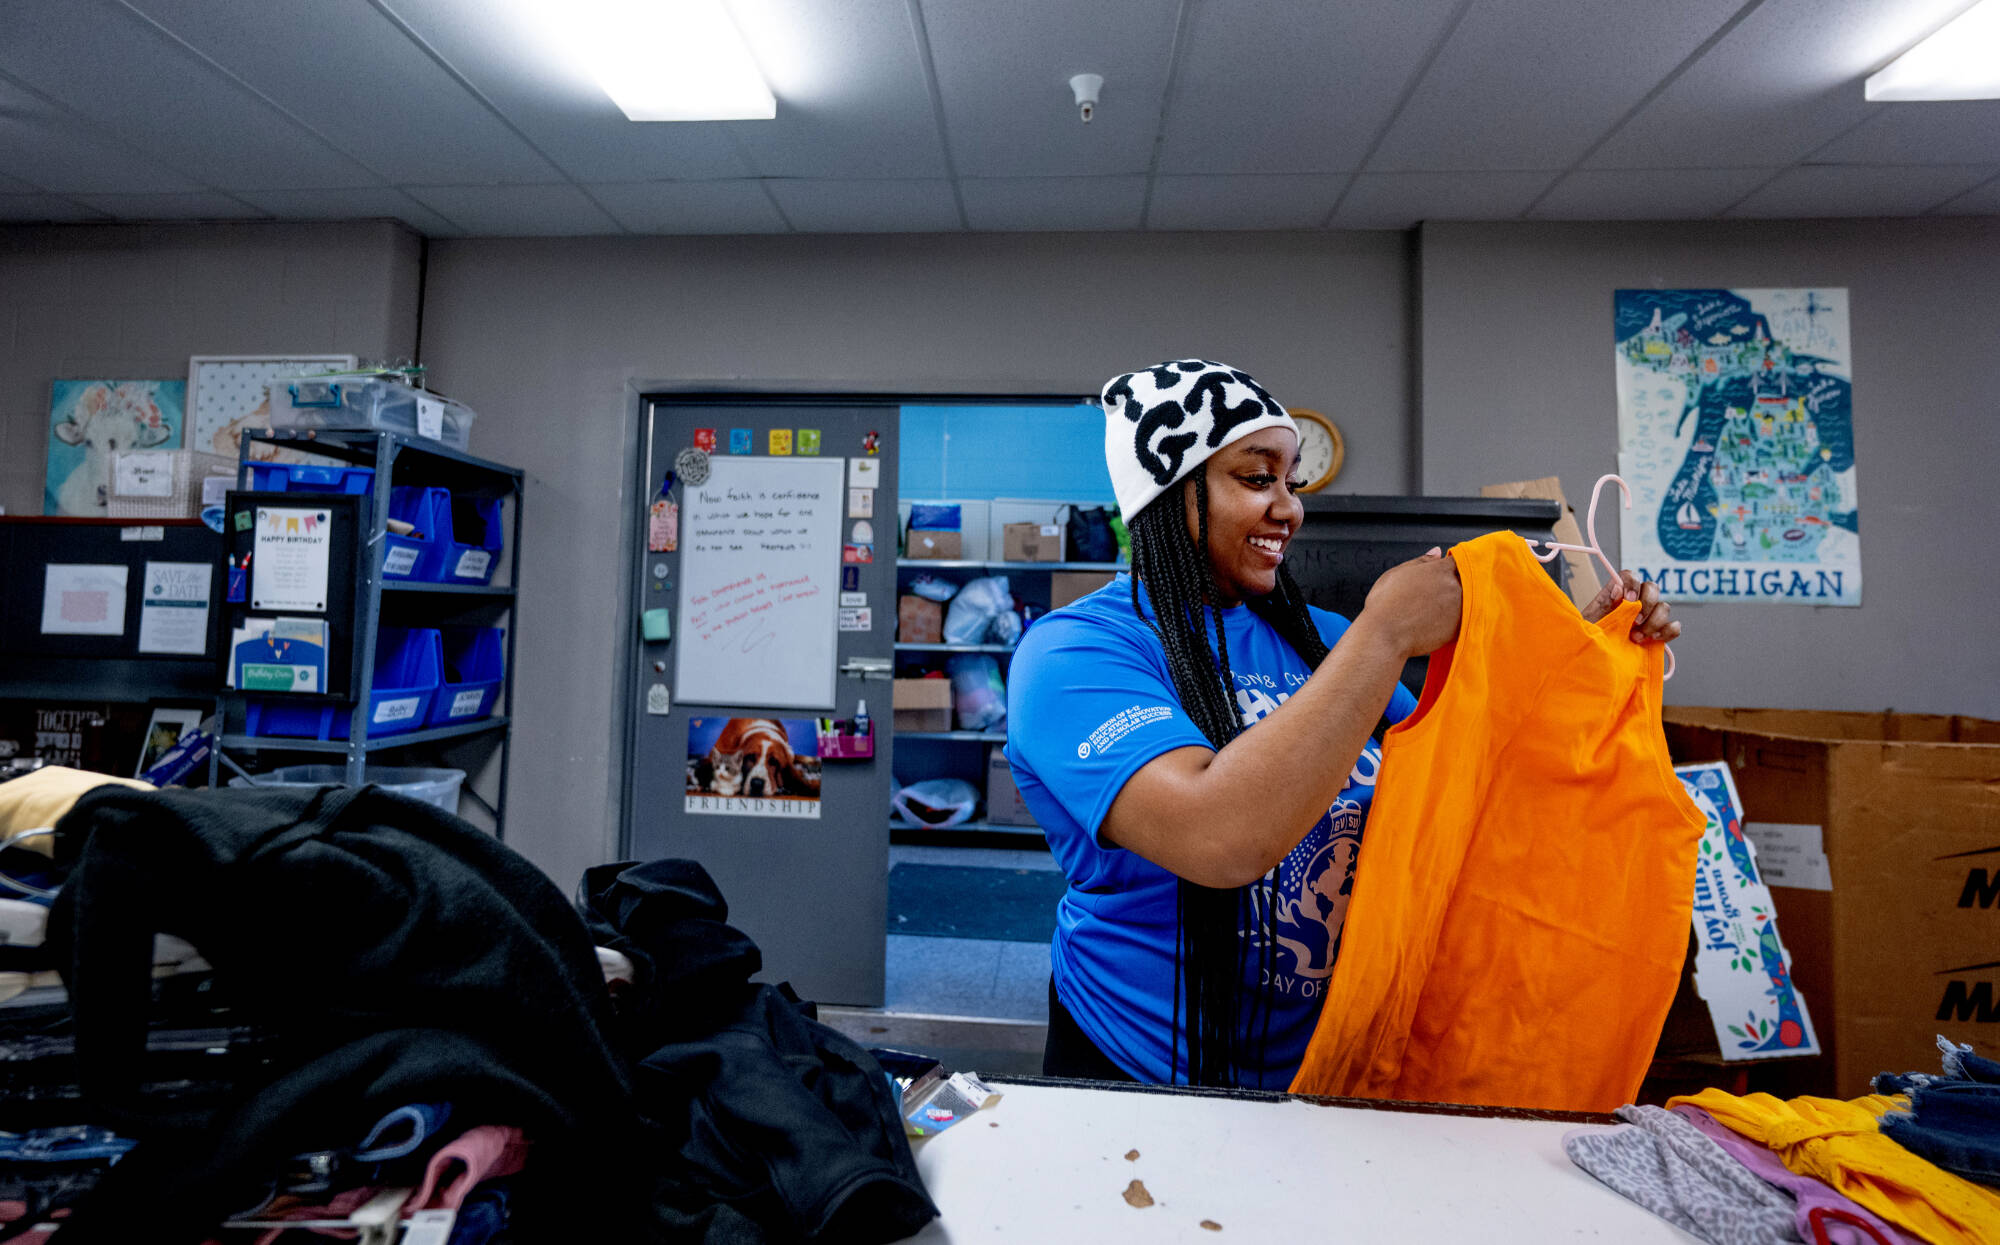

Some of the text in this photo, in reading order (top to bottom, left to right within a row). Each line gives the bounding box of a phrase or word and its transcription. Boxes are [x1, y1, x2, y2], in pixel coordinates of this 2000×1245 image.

[261, 535, 323, 545] HAPPY BIRTHDAY
[1638, 567, 1843, 597] MICHIGAN
[1088, 705, 1141, 741] DIVISION OF K-12
[1092, 706, 1172, 746] EDUCATION INNOVATION
[1096, 711, 1173, 751] AND SCHOLAR SUCCESS
[688, 796, 817, 813] FRIENDSHIP
[1261, 967, 1295, 995] DAY
[1301, 980, 1322, 998] OF
